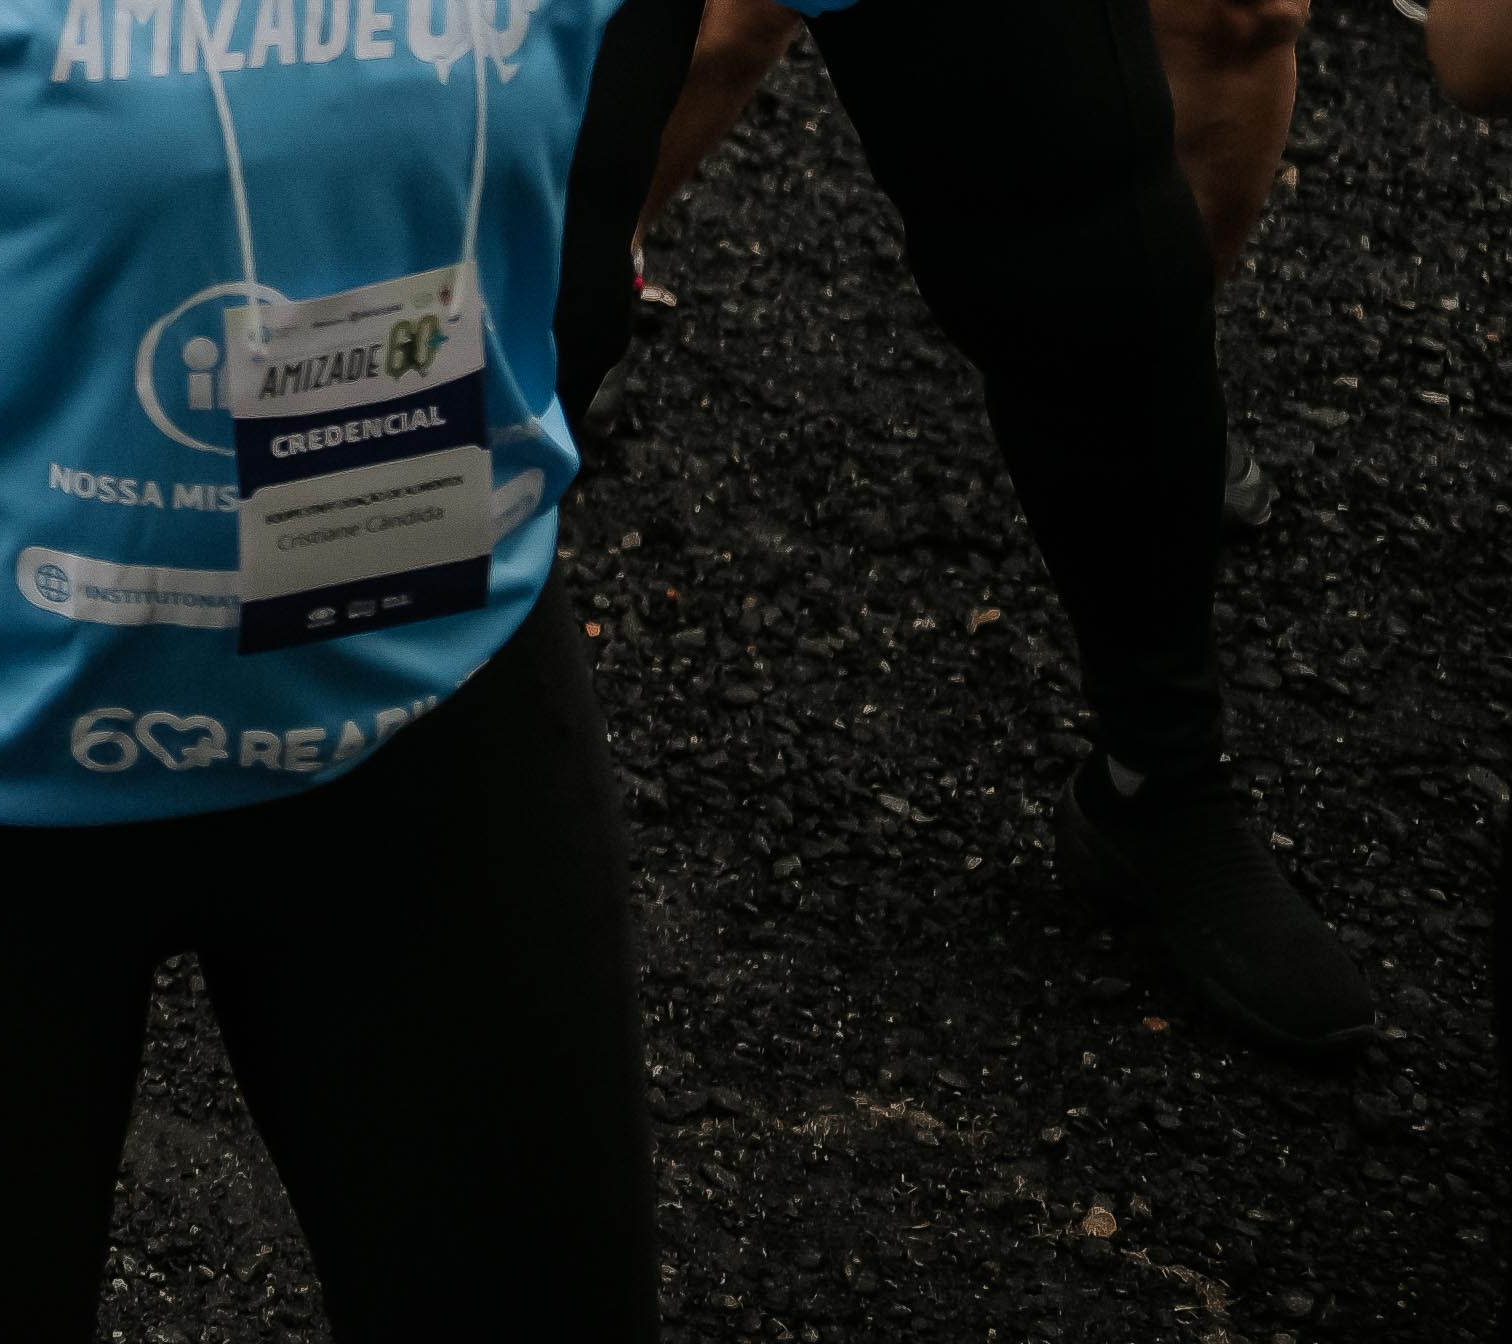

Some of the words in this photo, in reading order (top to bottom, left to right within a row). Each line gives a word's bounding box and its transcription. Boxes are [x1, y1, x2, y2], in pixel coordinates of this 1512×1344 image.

[258, 344, 383, 400] AMIZADE
[270, 406, 448, 459] CREDENCIAL
[49, 462, 164, 509] NOSSA
[173, 483, 241, 511] MIS
